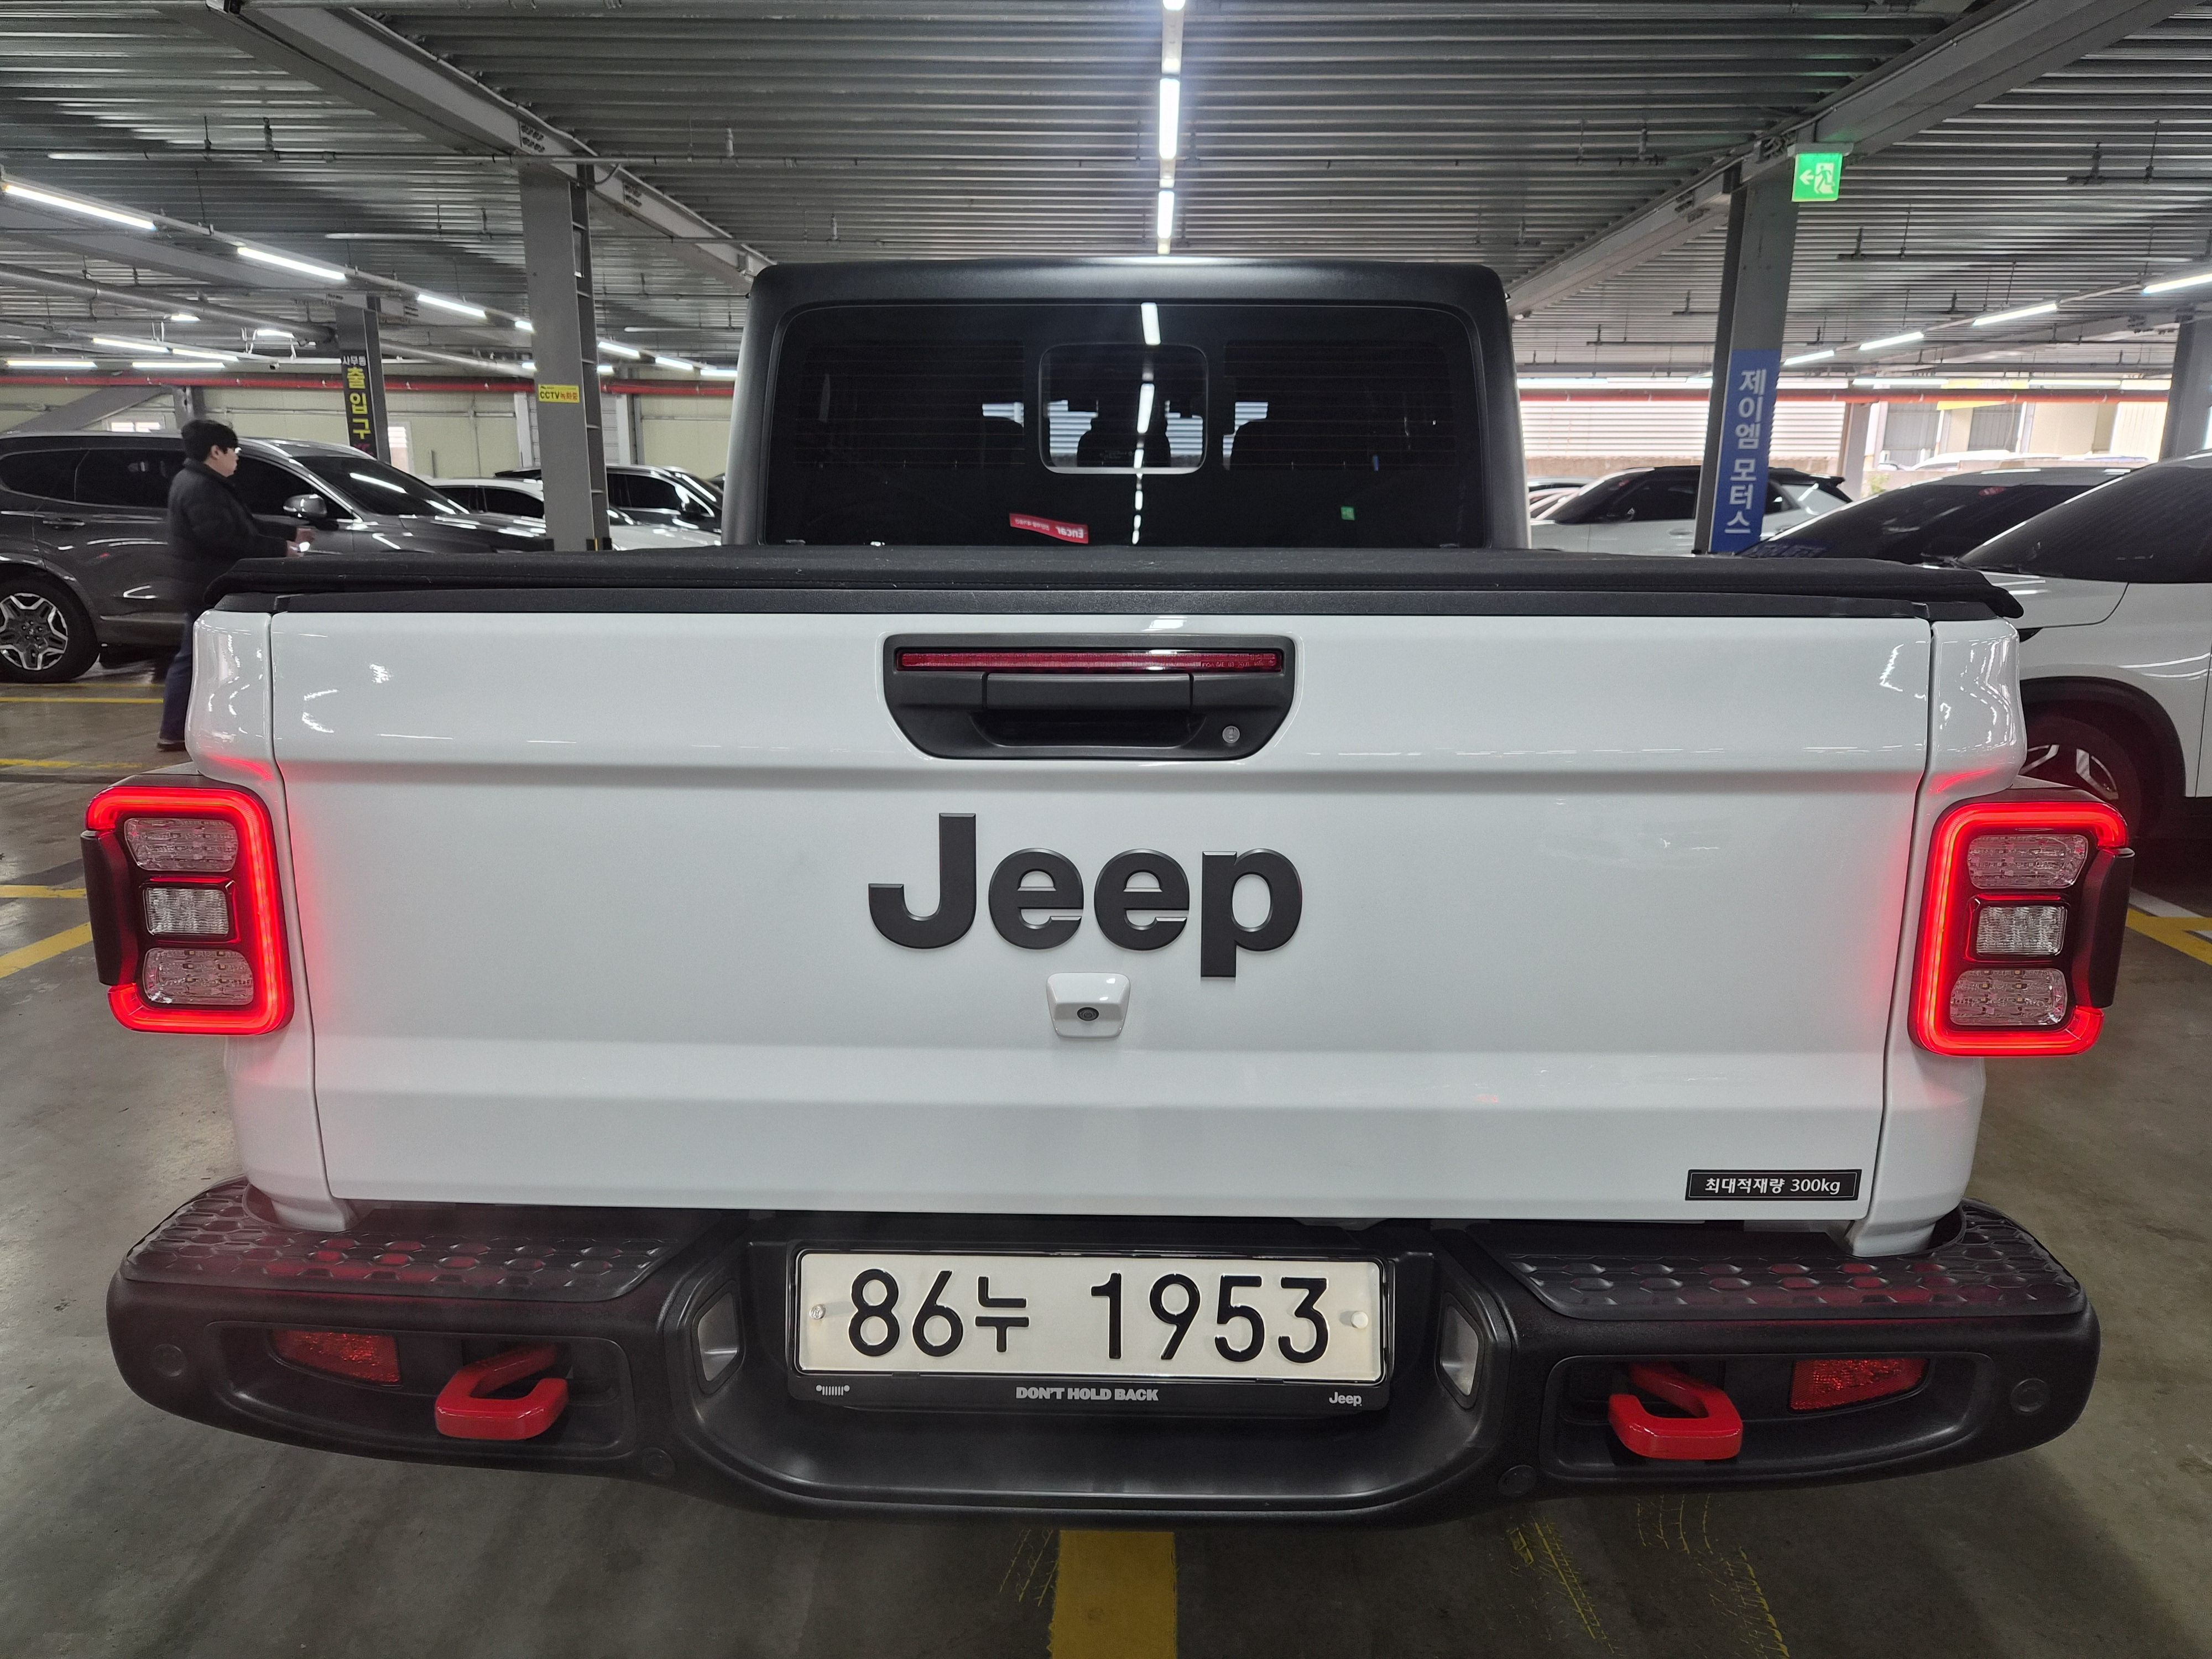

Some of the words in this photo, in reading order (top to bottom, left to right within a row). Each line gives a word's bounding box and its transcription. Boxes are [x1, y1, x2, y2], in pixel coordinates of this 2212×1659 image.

[347, 366, 371, 440] 출입구
[1735, 368, 1767, 450] 제이엠
[1724, 458, 1757, 534] 모터스
[868, 813, 1303, 978] Jeep
[1705, 1178, 1786, 1194] 최대적재량
[1790, 1178, 1841, 1194] 300kg
[848, 1268, 1030, 1358] 86누
[1091, 1272, 1329, 1363] 1953
[1016, 1387, 1065, 1400] DON'T
[1067, 1388, 1112, 1400] HOLD
[1114, 1389, 1159, 1401] BACK
[1329, 1391, 1362, 1407] Jeep
